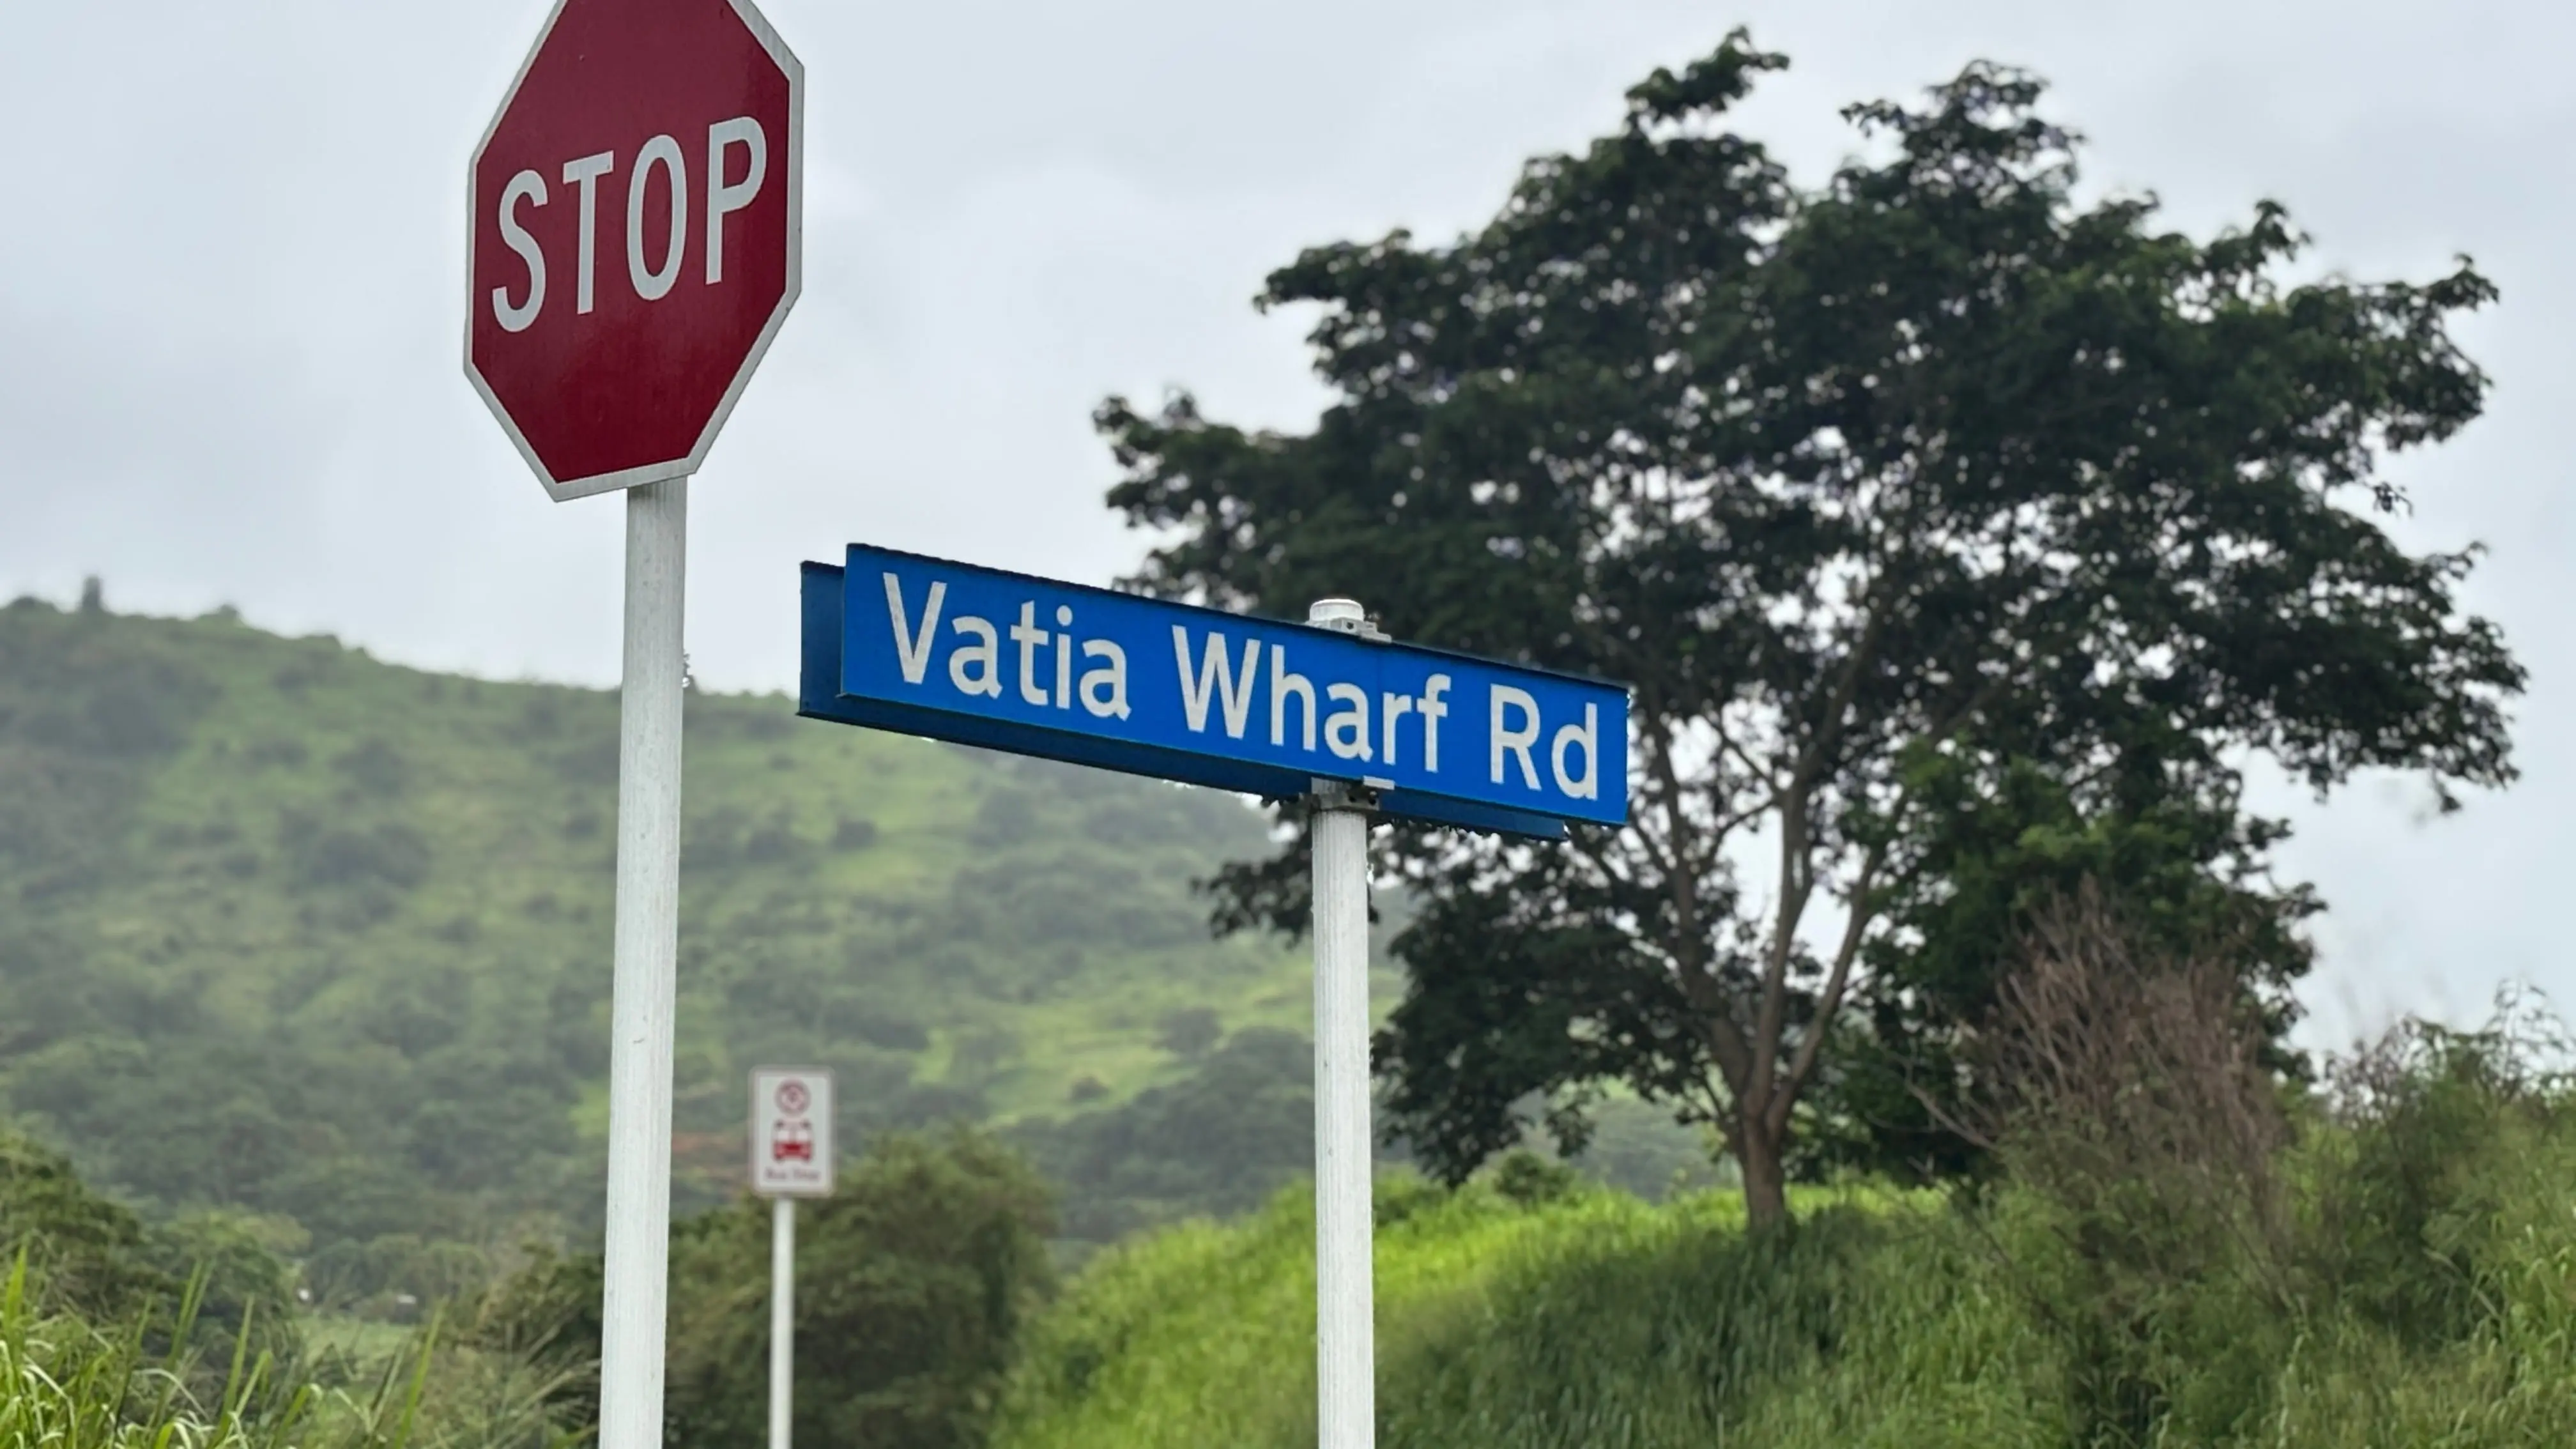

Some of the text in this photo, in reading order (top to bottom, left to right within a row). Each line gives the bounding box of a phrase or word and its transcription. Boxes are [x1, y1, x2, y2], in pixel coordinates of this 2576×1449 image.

[492, 116, 767, 332] STOP
[883, 572, 1599, 801] Vatia Wharf Rd
